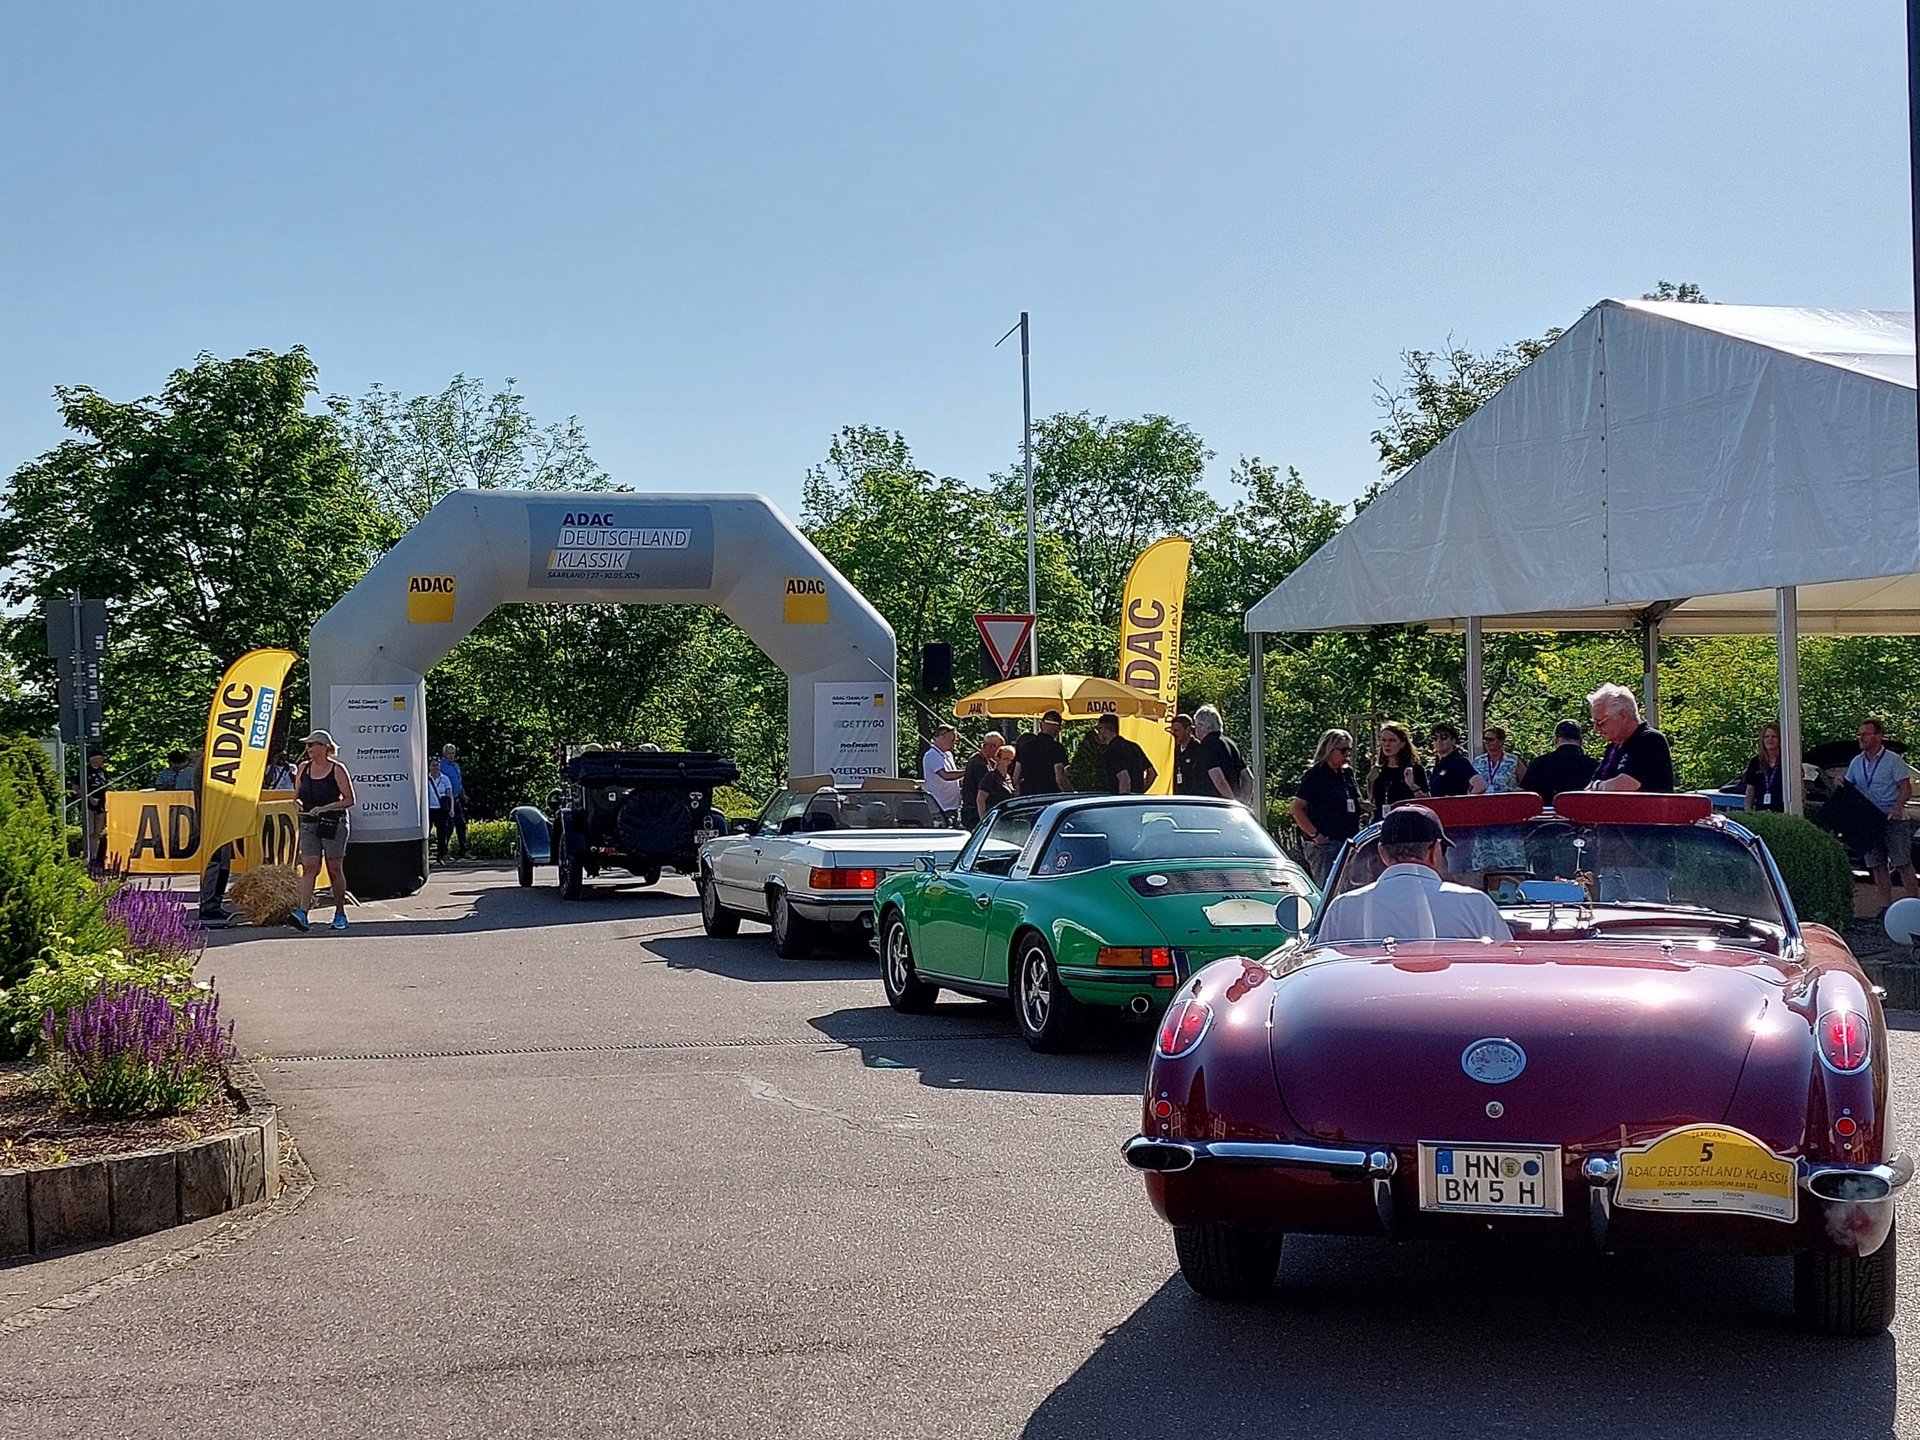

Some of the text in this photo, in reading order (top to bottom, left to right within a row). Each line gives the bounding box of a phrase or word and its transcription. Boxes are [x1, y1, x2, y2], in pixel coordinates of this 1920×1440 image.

[562, 513, 614, 526] ADAC
[563, 530, 687, 546] DEUTSCHLAND
[557, 552, 625, 568] KLASSIK
[547, 571, 586, 579] SAARLAND
[409, 577, 454, 593] ADAC
[786, 579, 825, 594] ADAC
[1126, 598, 1165, 697] DAC
[1166, 630, 1178, 690] Saarland
[1086, 701, 1117, 713] ADAC
[251, 693, 274, 747] Reisen
[841, 719, 885, 728] GETTYGO
[210, 682, 254, 785] ADAC
[358, 724, 407, 733] GETTYGO
[362, 802, 399, 811] UNION
[262, 813, 298, 866] AD
[1699, 1142, 1715, 1163] 5
[1442, 1165, 1449, 1173] D
[1465, 1155, 1499, 1178] HN
[1627, 1166, 1656, 1177] ADAC
[1659, 1165, 1742, 1177] DEUTSCHLAND
[1445, 1179, 1536, 1205] BM 5 H
